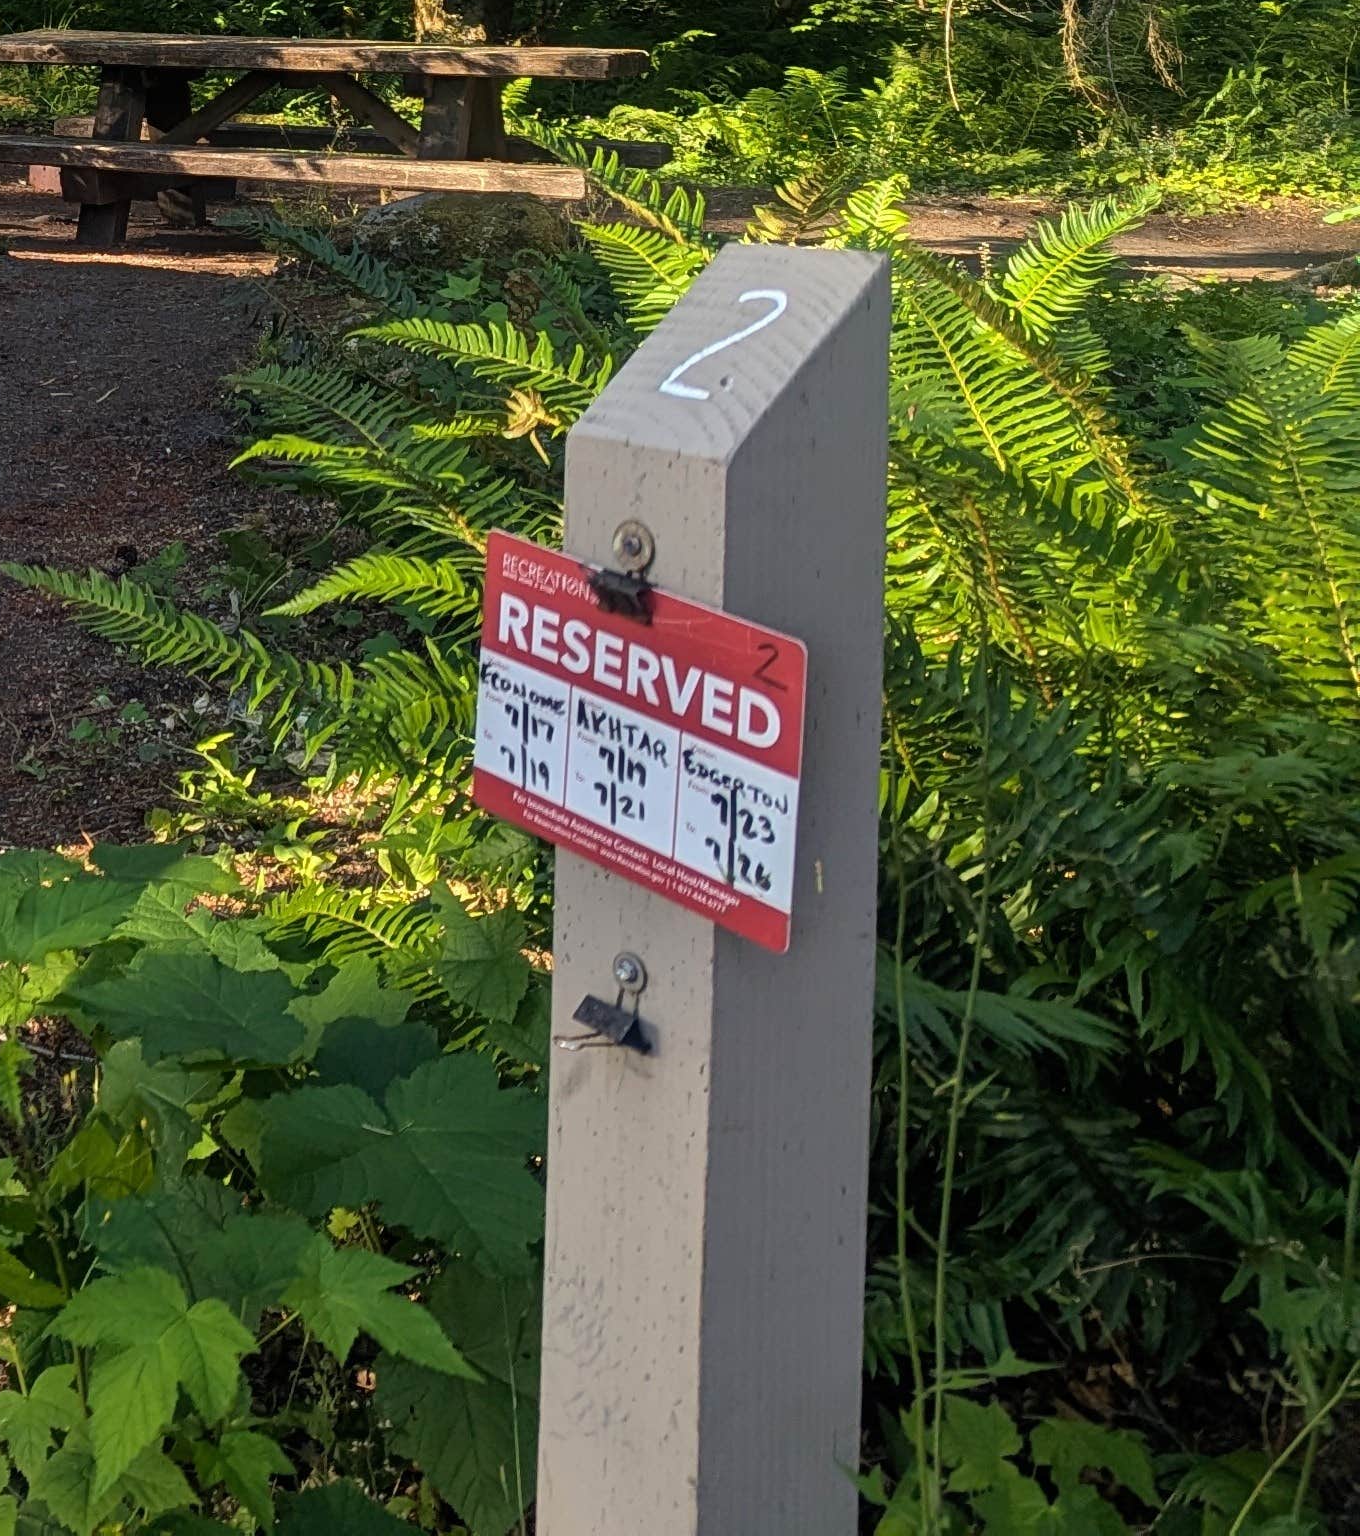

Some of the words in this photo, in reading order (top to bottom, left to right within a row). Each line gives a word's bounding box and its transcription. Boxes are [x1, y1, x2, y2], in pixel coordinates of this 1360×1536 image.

[658, 289, 788, 400] 2
[497, 592, 781, 749] RESERVED
[752, 642, 788, 691] 2
[576, 699, 669, 768] AKHTAR
[594, 782, 645, 825] 7/21
